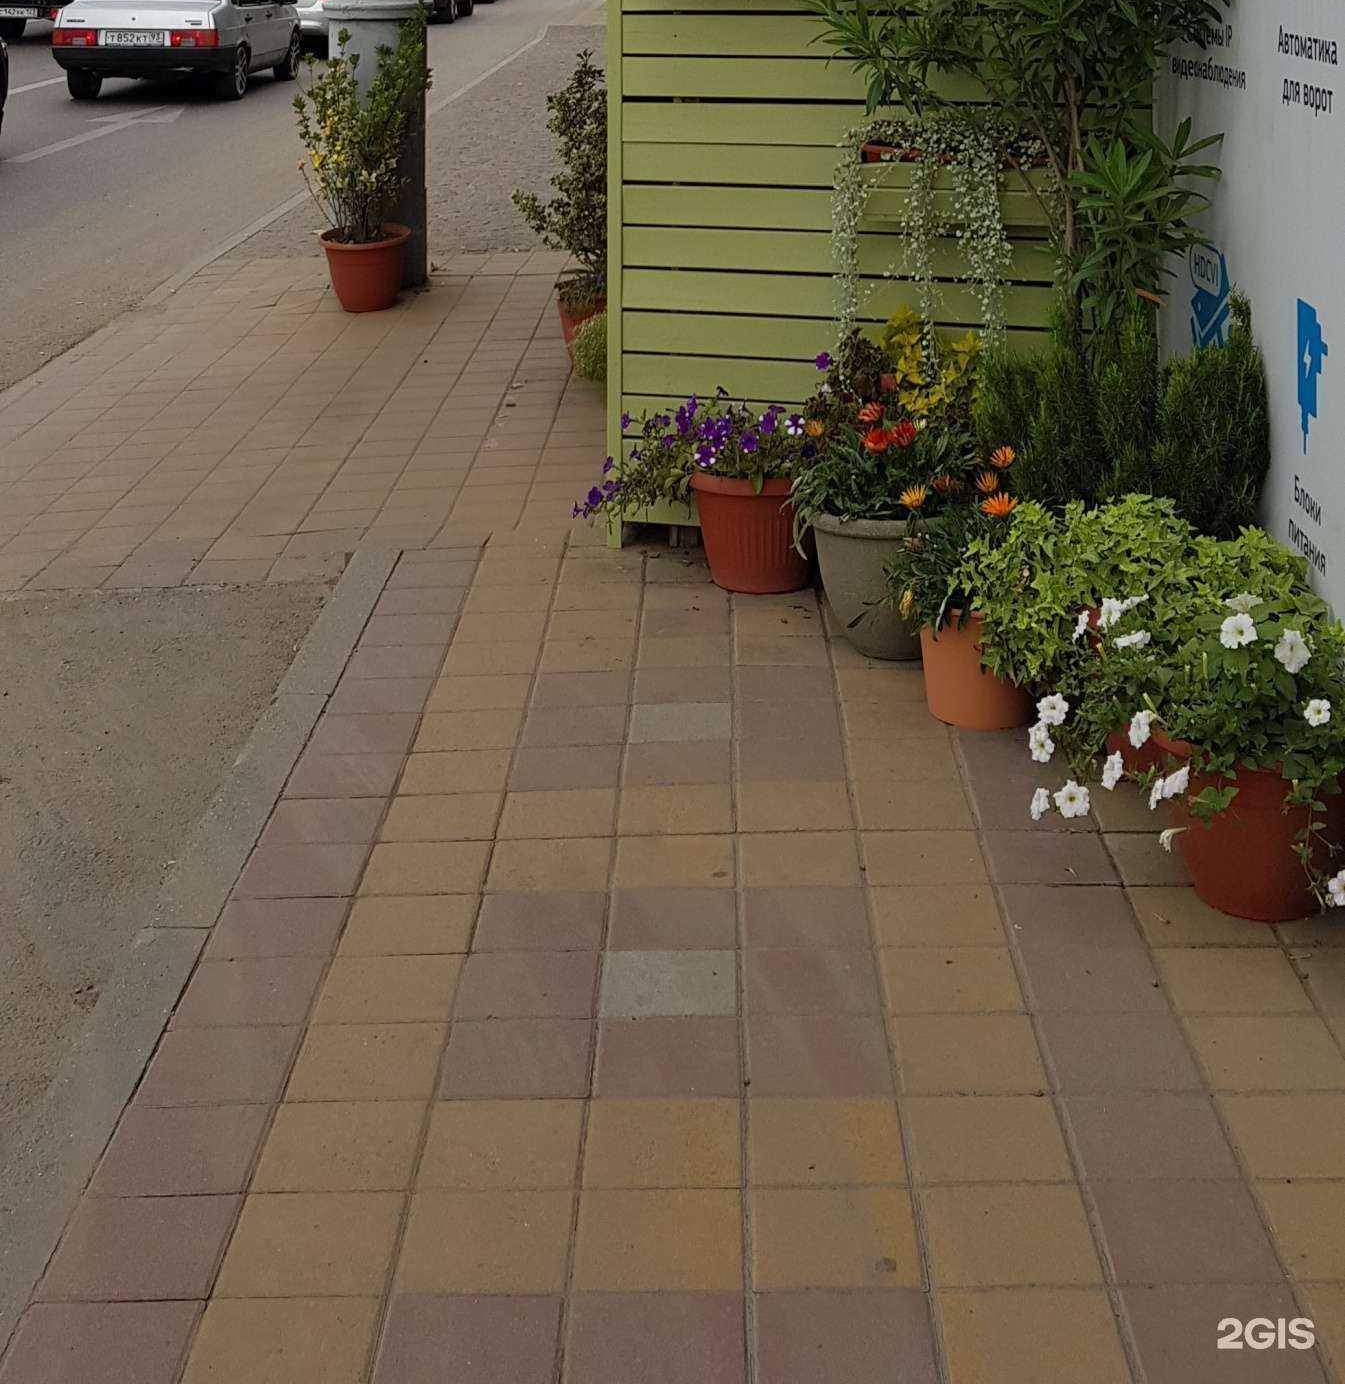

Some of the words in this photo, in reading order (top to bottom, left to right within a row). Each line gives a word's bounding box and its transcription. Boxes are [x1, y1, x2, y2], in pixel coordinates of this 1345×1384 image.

[1278, 24, 1338, 66] Автоматика
[1171, 57, 1247, 91] видеонаблюдения
[1282, 78, 1300, 105] для
[1303, 83, 1333, 118] ворот
[1294, 474, 1322, 527] Блоки
[1288, 518, 1326, 577] питания
